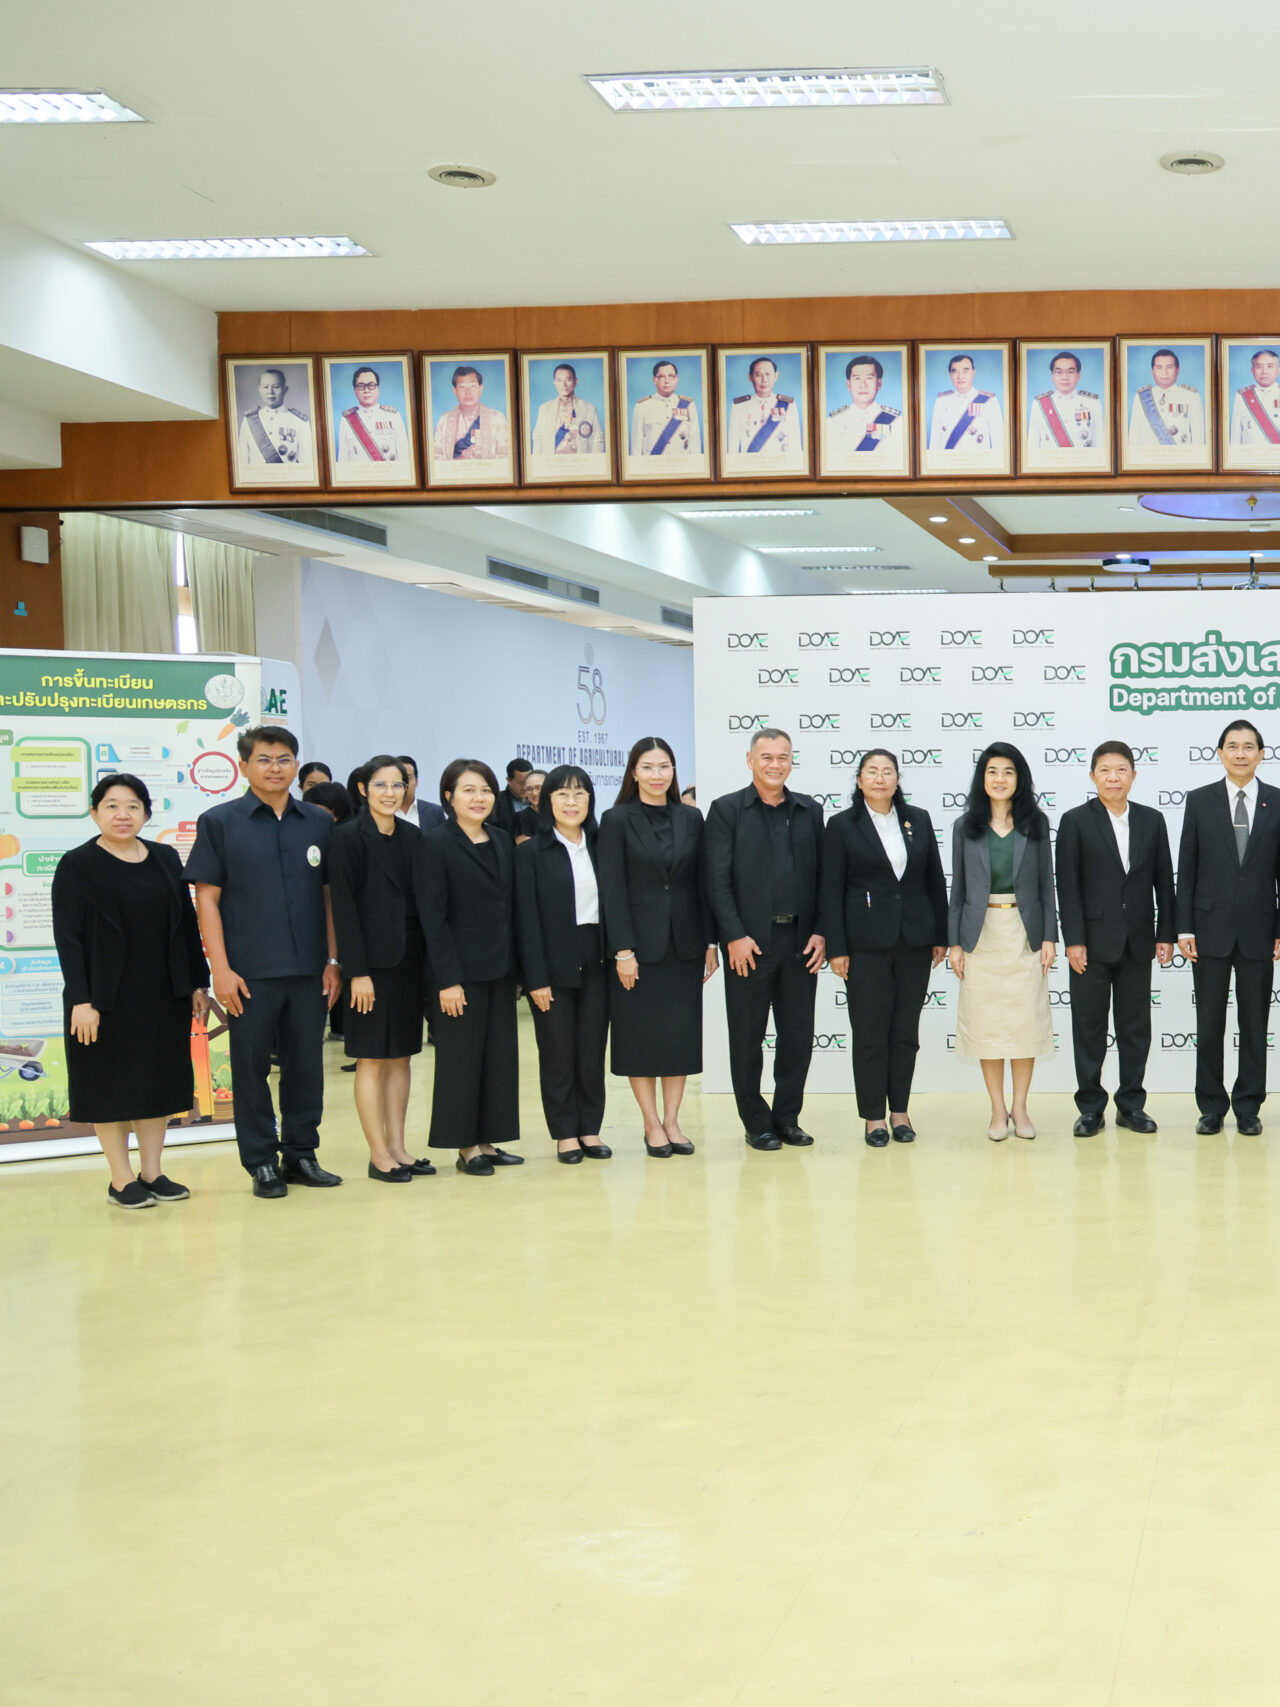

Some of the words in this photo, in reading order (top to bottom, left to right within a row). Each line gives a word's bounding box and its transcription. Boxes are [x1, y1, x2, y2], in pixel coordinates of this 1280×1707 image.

[40, 668, 154, 690] การขึ้นทะเบียน
[576, 666, 607, 726] 58
[1112, 685, 1246, 709] Department
[1253, 684, 1276, 706] of
[516, 743, 566, 765] DEPARTMENT
[569, 747, 577, 765] OF
[580, 748, 626, 767] AGRICULTURAL
